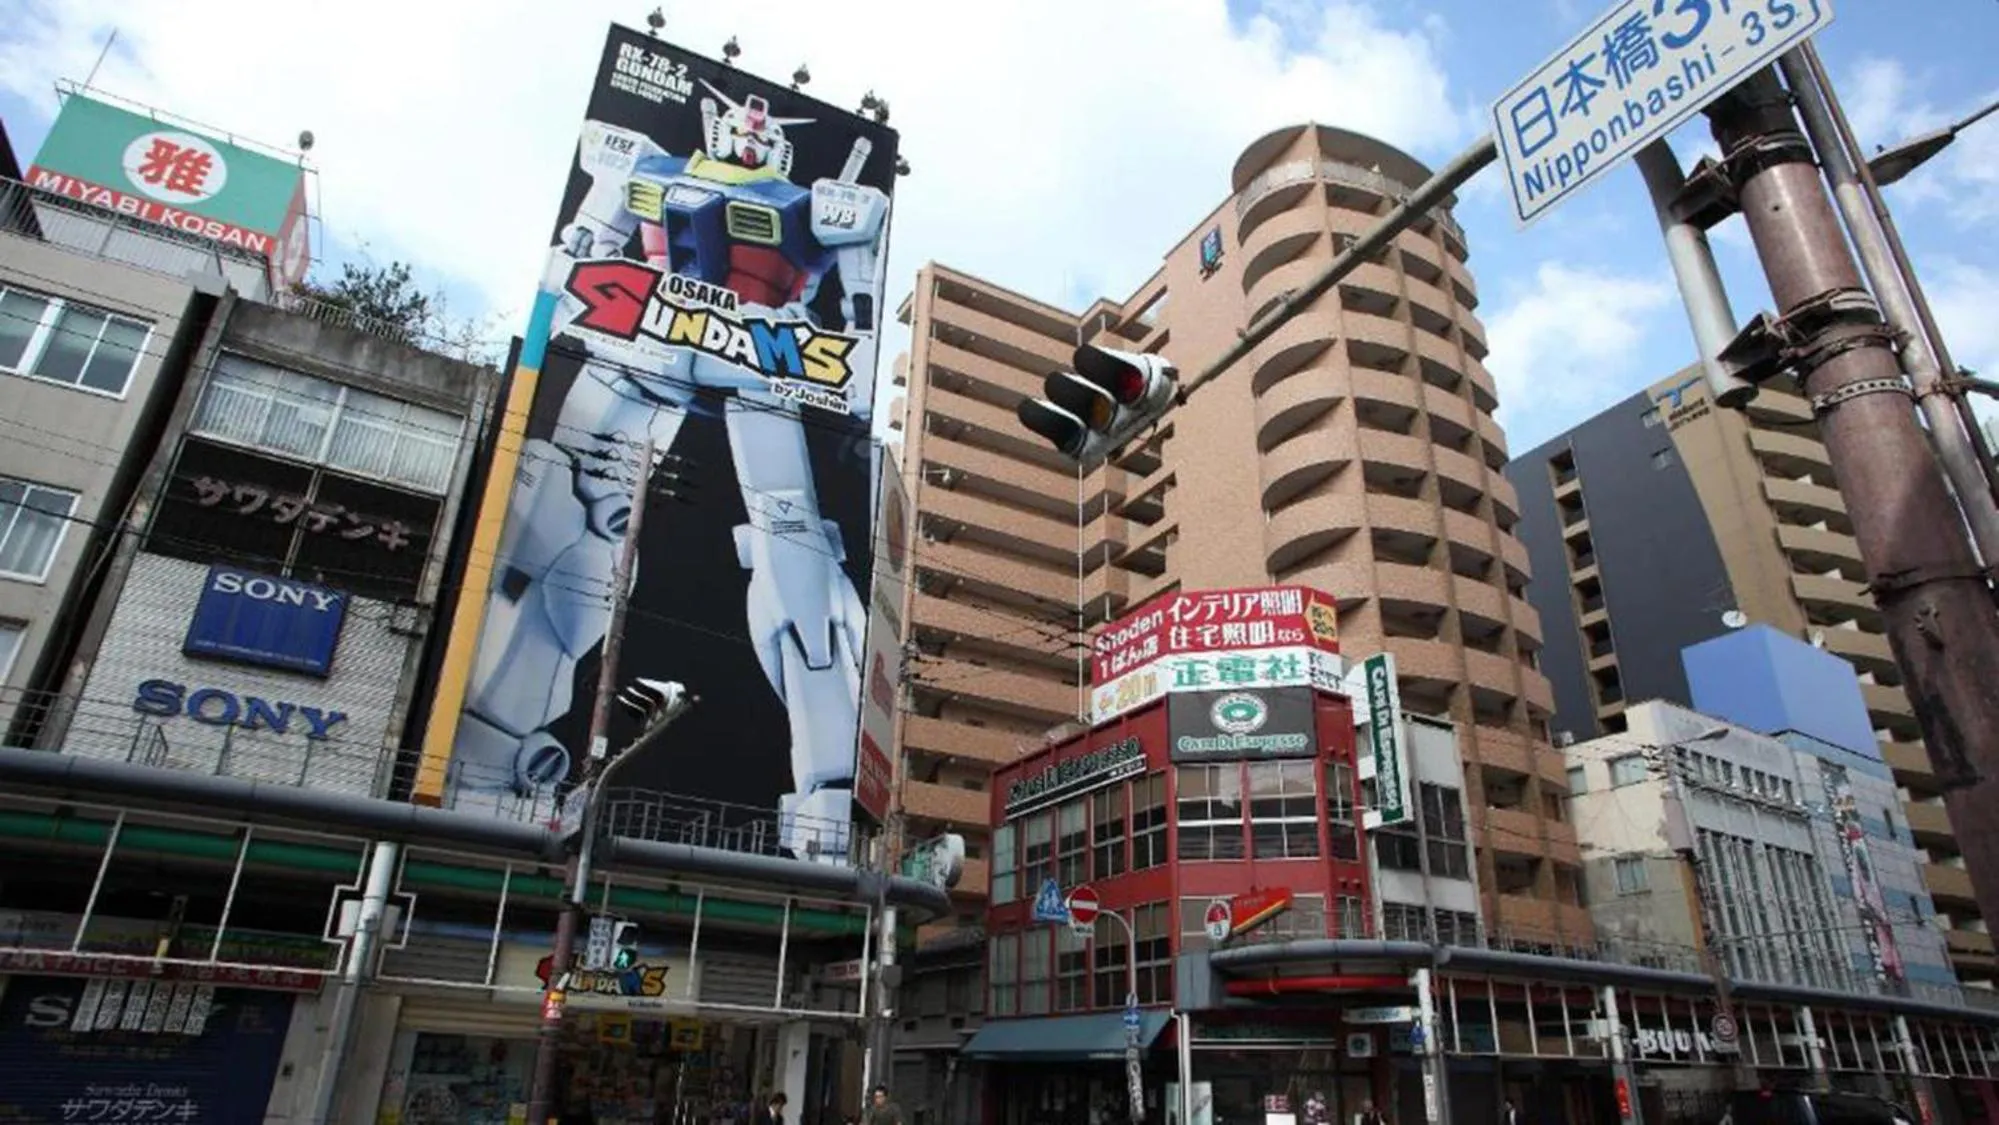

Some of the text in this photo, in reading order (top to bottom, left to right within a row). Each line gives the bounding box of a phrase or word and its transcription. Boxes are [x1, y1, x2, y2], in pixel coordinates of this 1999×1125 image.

[137, 137, 214, 196] 雅
[33, 170, 268, 253] MIYABI KOSAN
[668, 275, 737, 311] OSAKA
[774, 382, 849, 414] by Joshin
[192, 475, 411, 551] サワダデンキ
[212, 571, 342, 612] SONY
[1167, 588, 1303, 622] インテリア照明
[1173, 652, 1304, 688] 正電社
[132, 678, 347, 740] SONY
[60, 1097, 200, 1121] サワダデンキ
